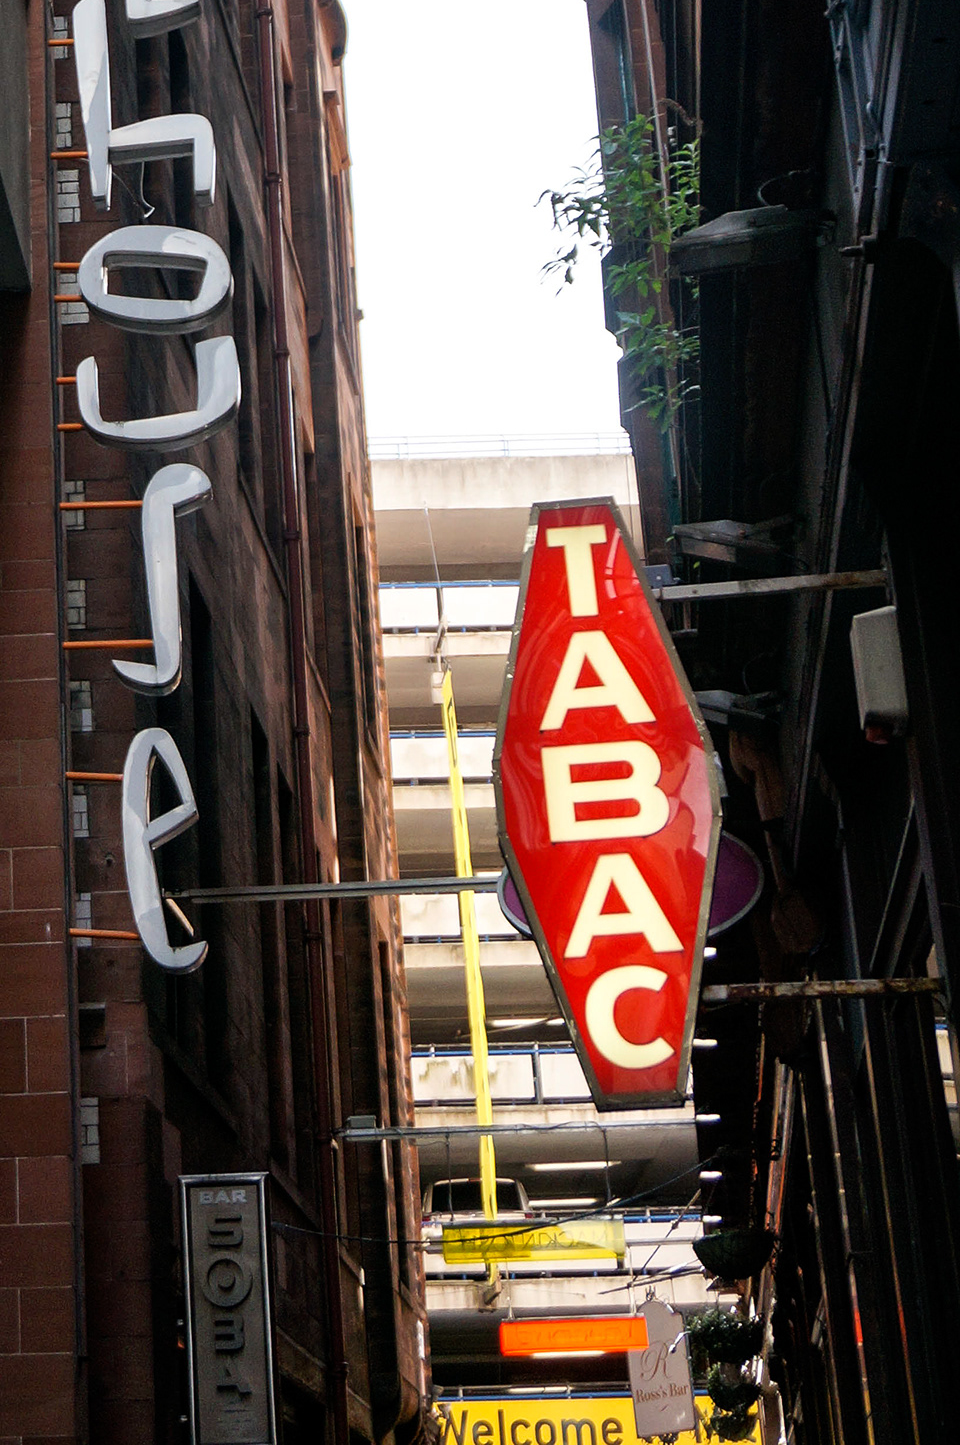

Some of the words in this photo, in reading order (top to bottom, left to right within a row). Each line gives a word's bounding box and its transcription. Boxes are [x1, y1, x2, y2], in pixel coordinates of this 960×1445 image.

[540, 524, 685, 1070] TABAC
[198, 1189, 248, 1206] BAR
[669, 1381, 690, 1398] Bar
[439, 1406, 624, 1445] Welcome
